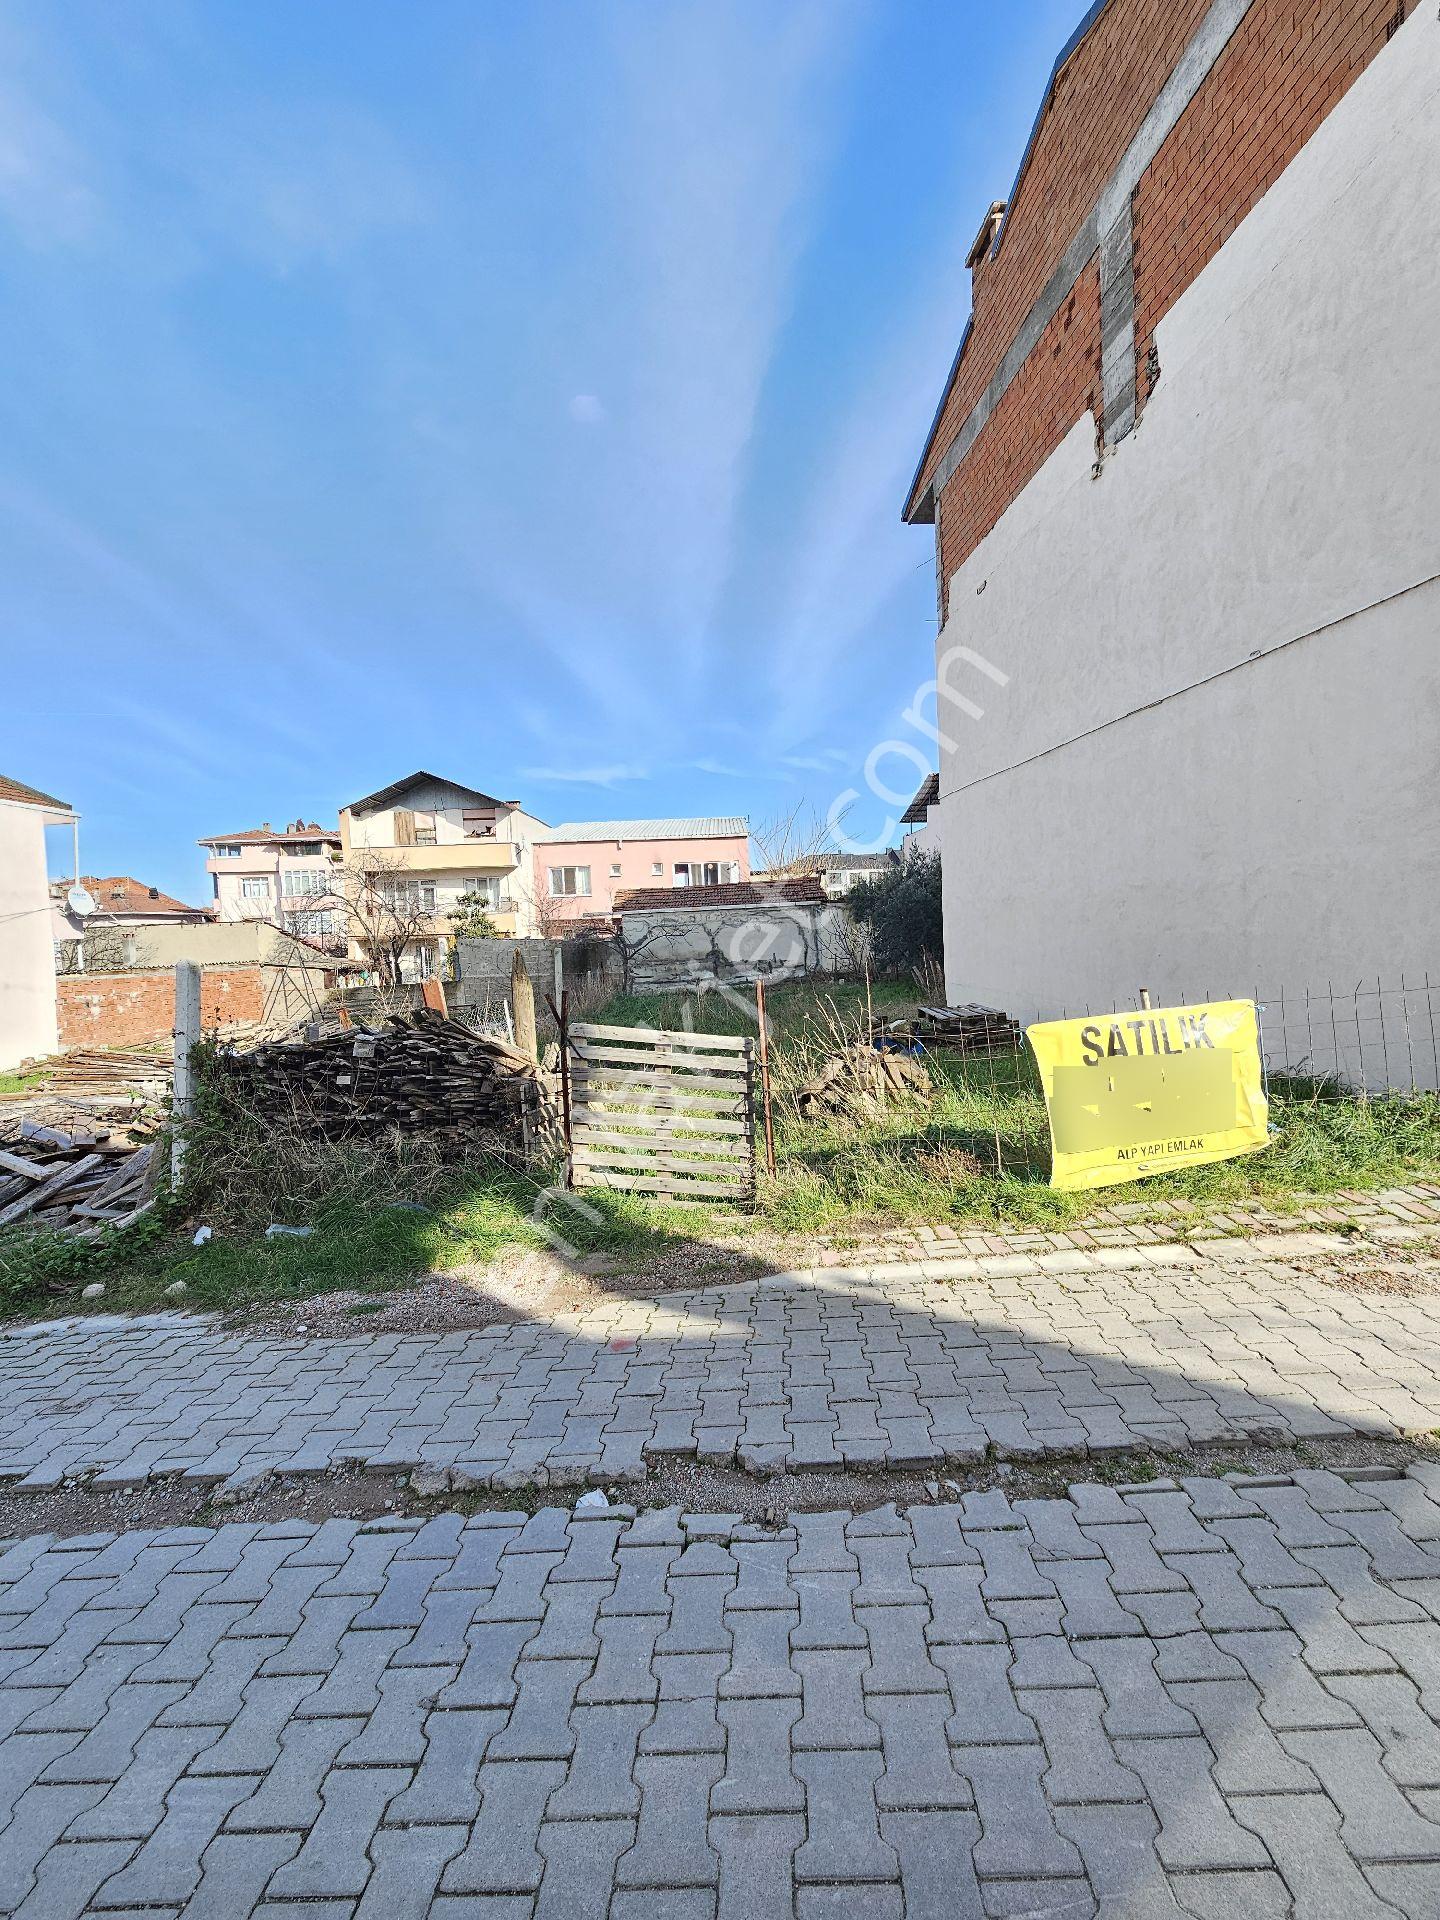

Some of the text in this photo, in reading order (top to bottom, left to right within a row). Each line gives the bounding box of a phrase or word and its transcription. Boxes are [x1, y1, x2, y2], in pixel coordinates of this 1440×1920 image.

[1081, 1013, 1215, 1067] SATILIK
[1117, 1138, 1204, 1160] ALP YAPI EMLAK
